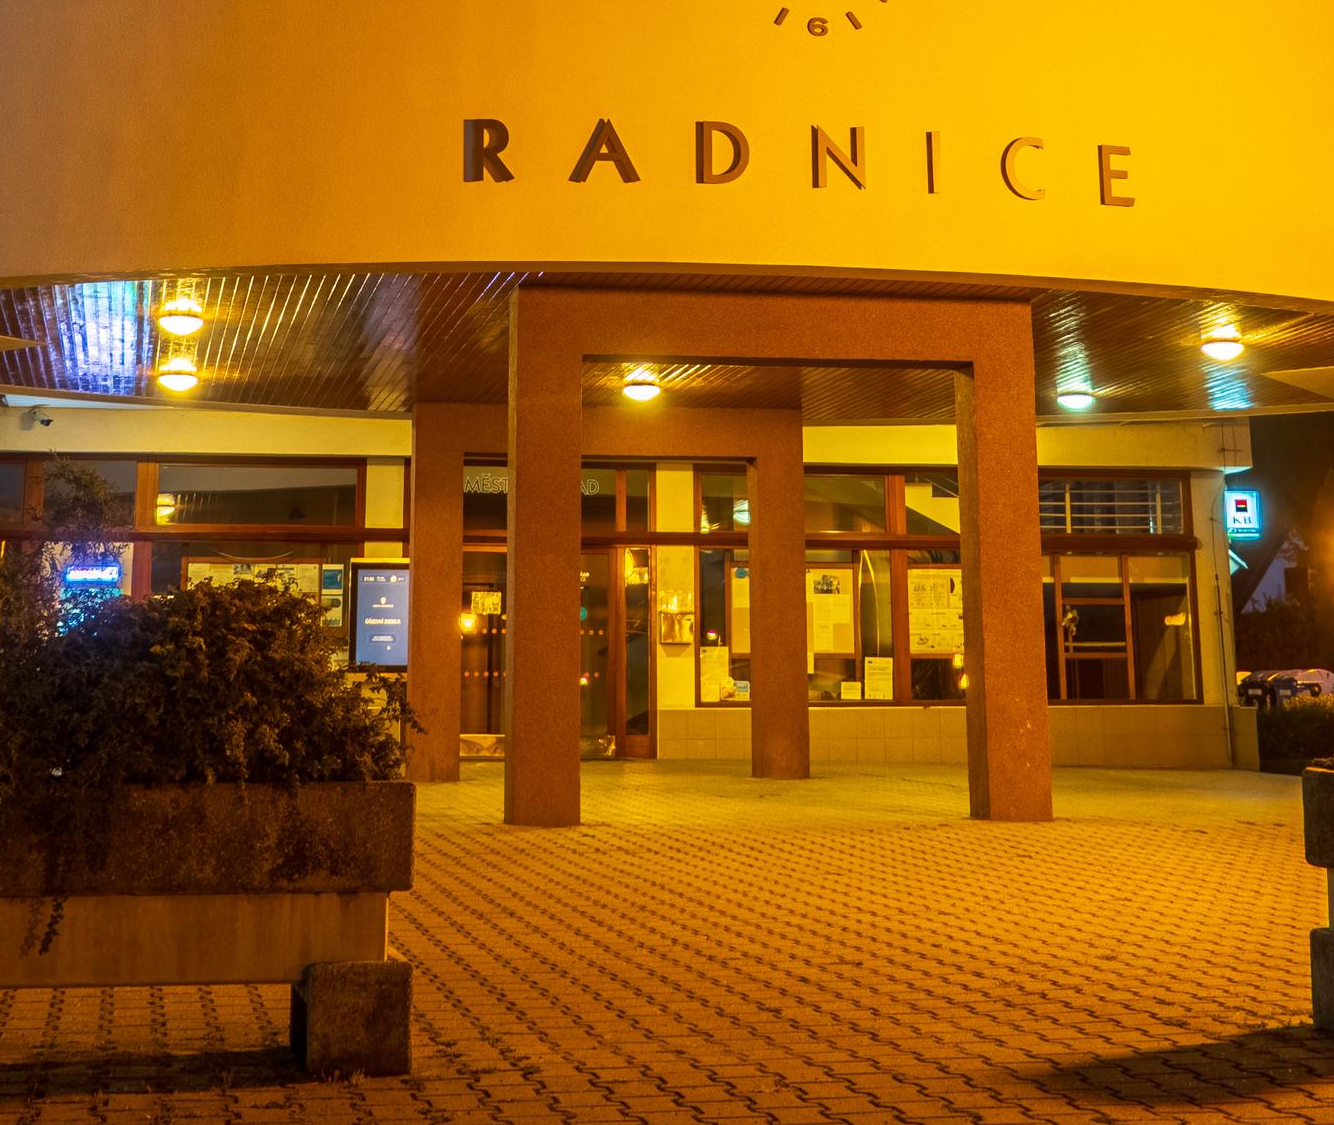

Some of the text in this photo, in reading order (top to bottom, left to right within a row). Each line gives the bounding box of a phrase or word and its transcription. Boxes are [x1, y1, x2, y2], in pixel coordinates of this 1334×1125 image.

[806, 17, 828, 37] 6
[462, 117, 1136, 207] RADNICE
[1233, 516, 1252, 524] KB
